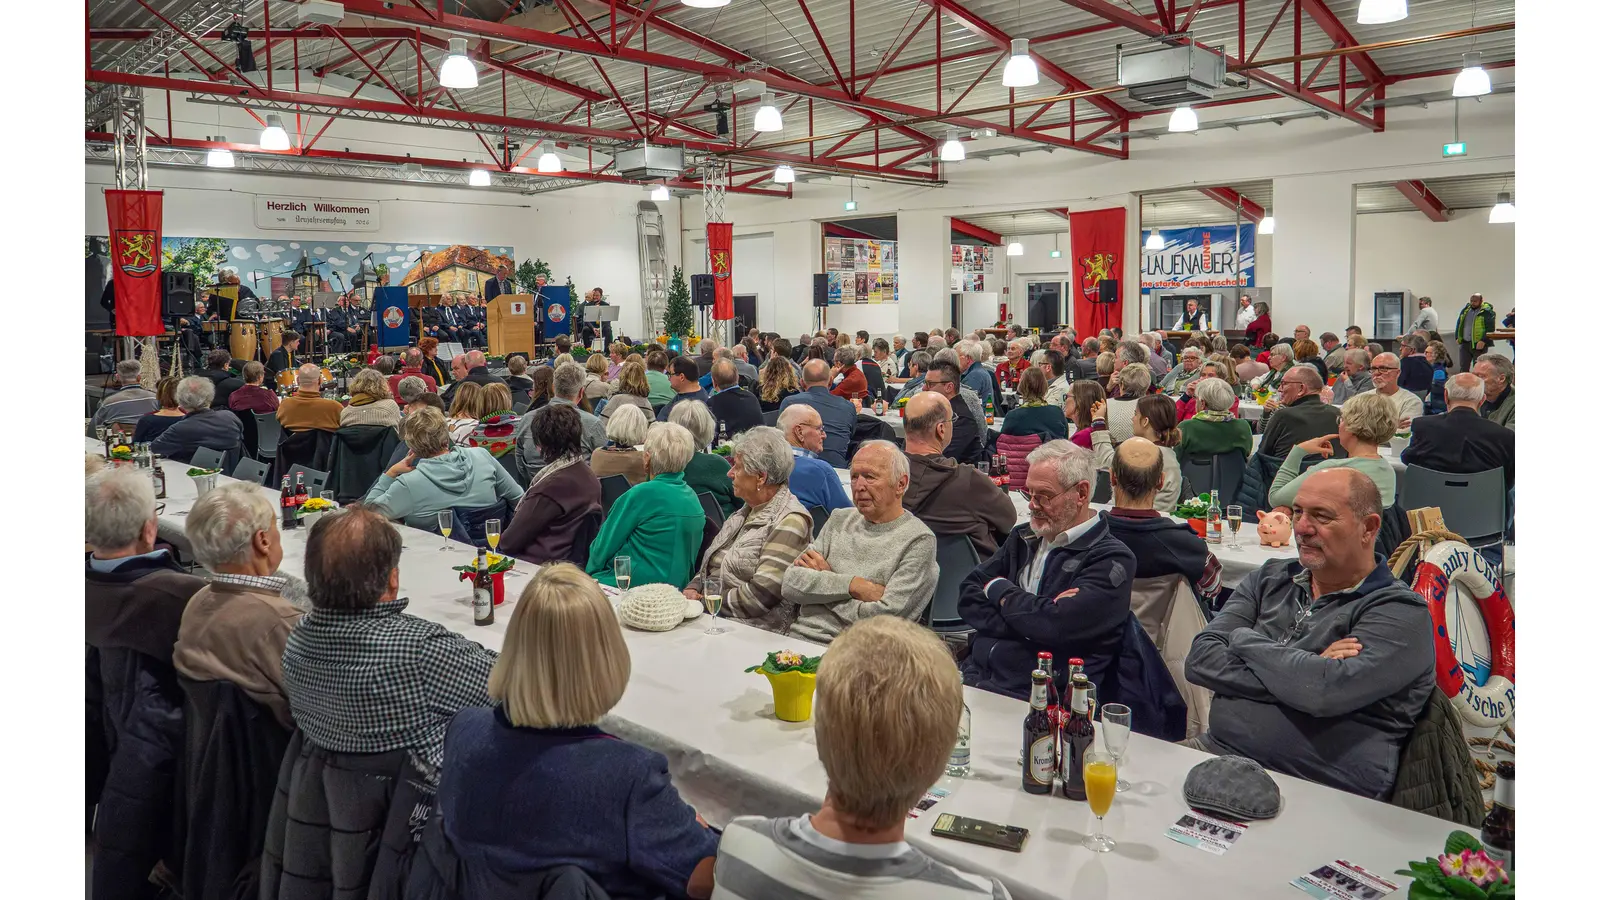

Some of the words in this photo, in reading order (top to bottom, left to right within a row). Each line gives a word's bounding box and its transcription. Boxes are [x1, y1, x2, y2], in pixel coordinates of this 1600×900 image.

[267, 201, 307, 212] Herzlich
[314, 203, 370, 214] Willkommen
[1202, 231, 1211, 269] RUNDE
[1147, 252, 1234, 276] LAUENAUER
[1140, 280, 1152, 288] ne
[1155, 279, 1181, 288] starke
[1183, 277, 1247, 288] Gemeinschat!
[1432, 547, 1469, 602] Shanty
